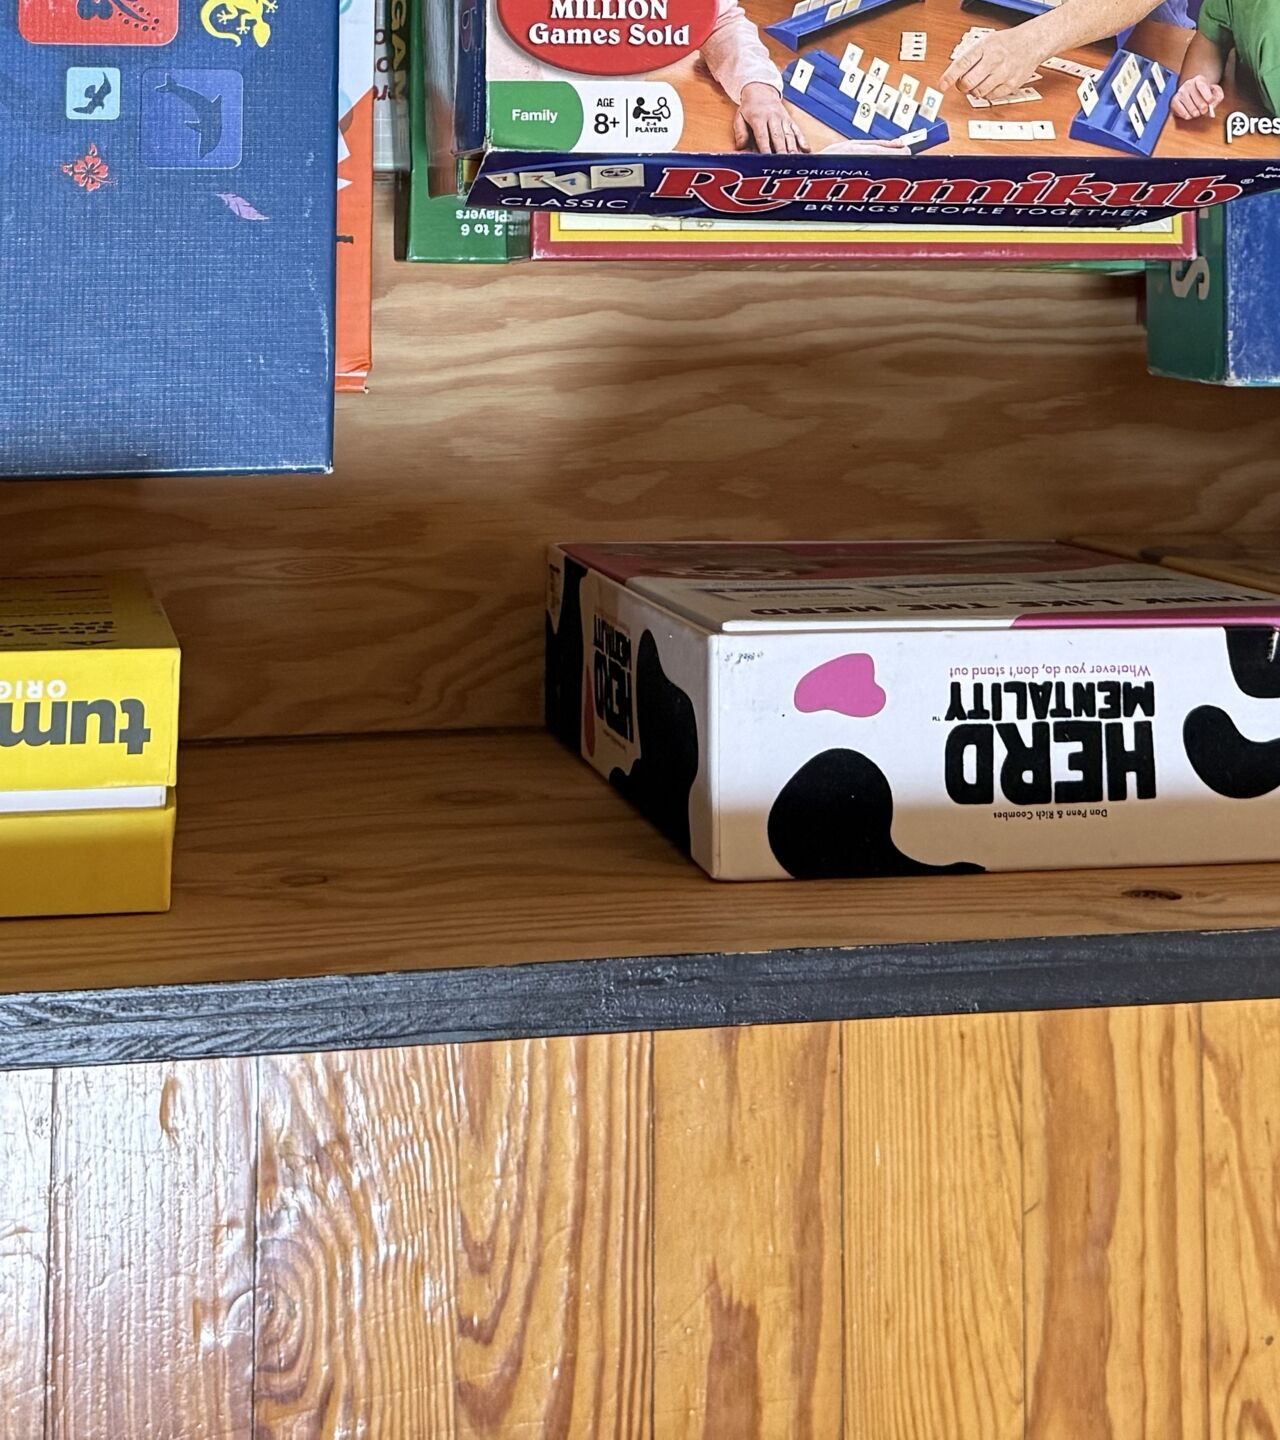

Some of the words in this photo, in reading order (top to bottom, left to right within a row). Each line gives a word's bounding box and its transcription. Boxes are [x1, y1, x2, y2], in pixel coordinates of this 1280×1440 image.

[528, 23, 621, 46] Games
[627, 23, 690, 47] Sold
[596, 98, 615, 107] AGE
[511, 108, 559, 125] Family
[592, 112, 621, 135] 8+
[635, 126, 668, 134] PLAYERS
[762, 168, 792, 176] THE
[796, 168, 872, 177] ORIGINAL
[649, 166, 1245, 215] Rummikub
[501, 198, 628, 209] CLASSIC
[805, 204, 899, 214] BRINGS
[911, 206, 1003, 217] PEOPLE
[1015, 207, 1148, 218] TOGETHER
[461, 224, 469, 236] 6
[474, 224, 489, 236] to
[494, 224, 503, 236] 2
[897, 603, 1000, 612] THE
[949, 667, 969, 677] out
[972, 667, 1005, 680] stand
[1010, 665, 1039, 676] don't
[1041, 663, 1061, 675] do,
[1065, 663, 1086, 674] you
[1089, 665, 1151, 677] Whatever
[944, 680, 1156, 722] MENTALITY
[944, 720, 1157, 806] HERD
[993, 810, 1034, 820] Coombes
[1036, 810, 1054, 819] Rich
[1057, 810, 1064, 818] &
[1066, 809, 1086, 818] Penn
[1090, 809, 1108, 818] Dan
